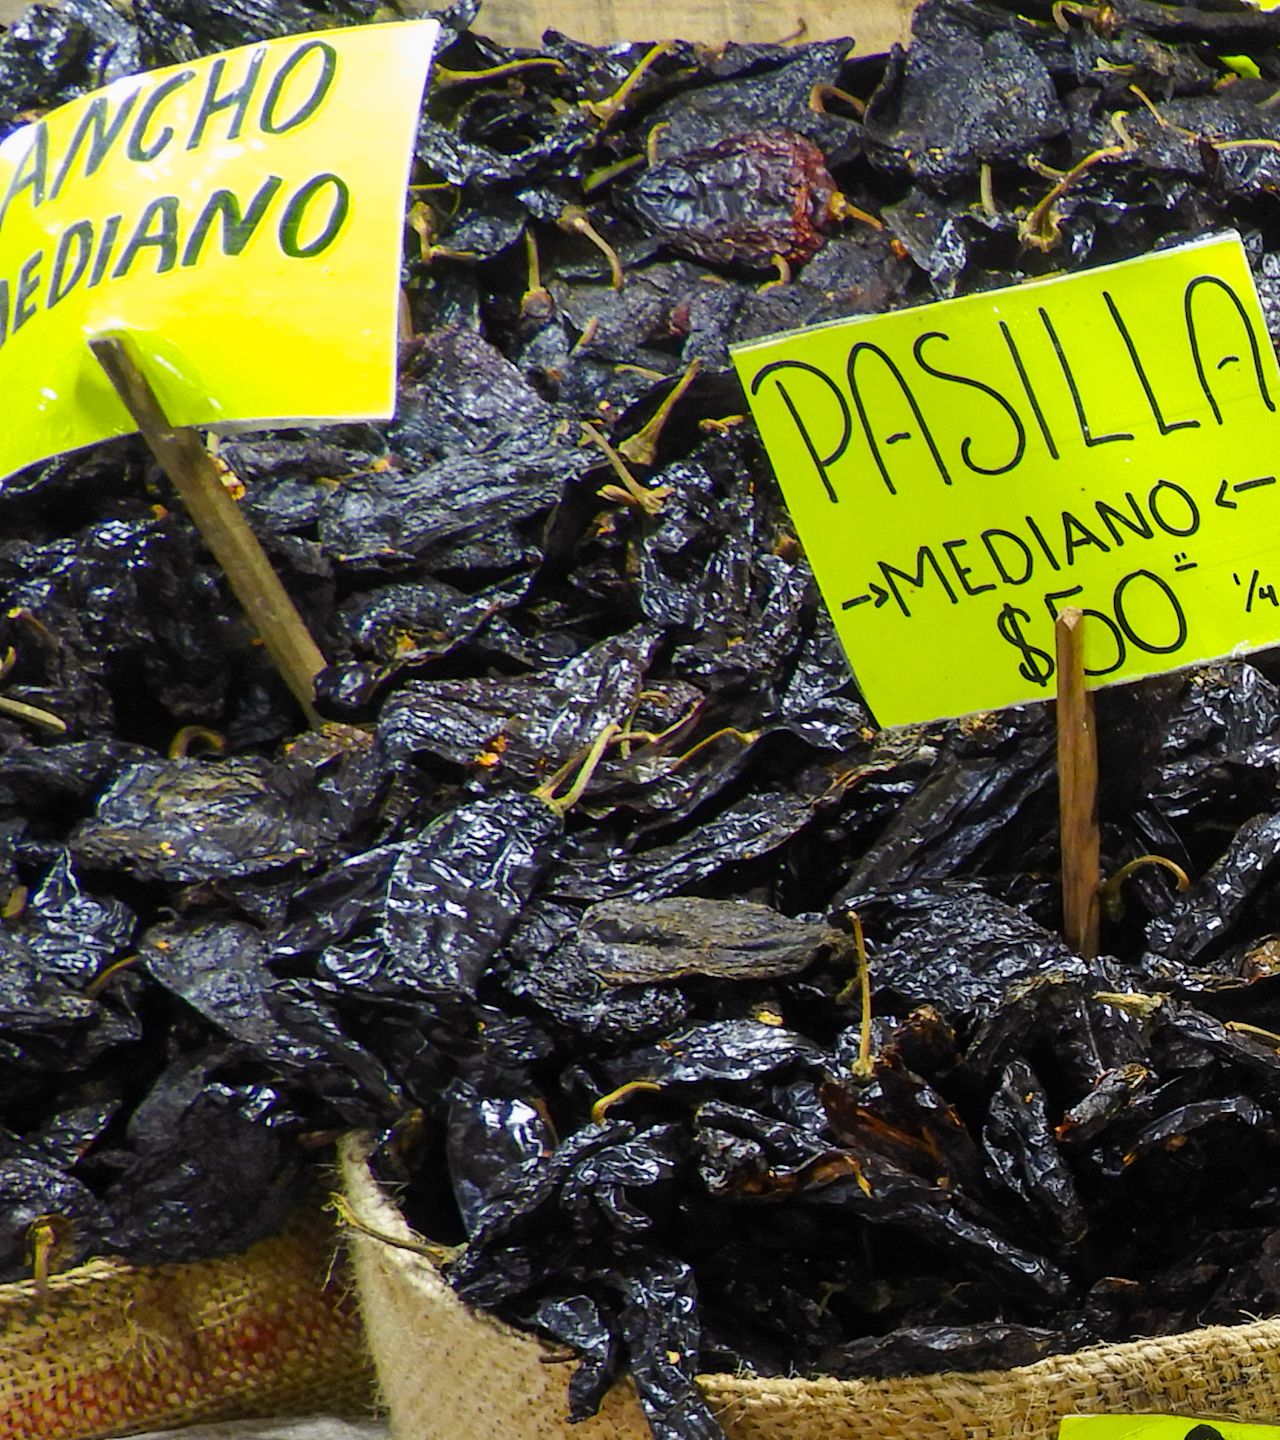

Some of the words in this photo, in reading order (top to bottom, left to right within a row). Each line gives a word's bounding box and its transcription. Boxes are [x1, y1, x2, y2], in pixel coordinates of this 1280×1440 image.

[0, 40, 338, 230] ANCHO
[751, 275, 1277, 503] PASILLA
[878, 479, 1201, 618] MEDIANO
[1231, 570, 1279, 613] 1/4
